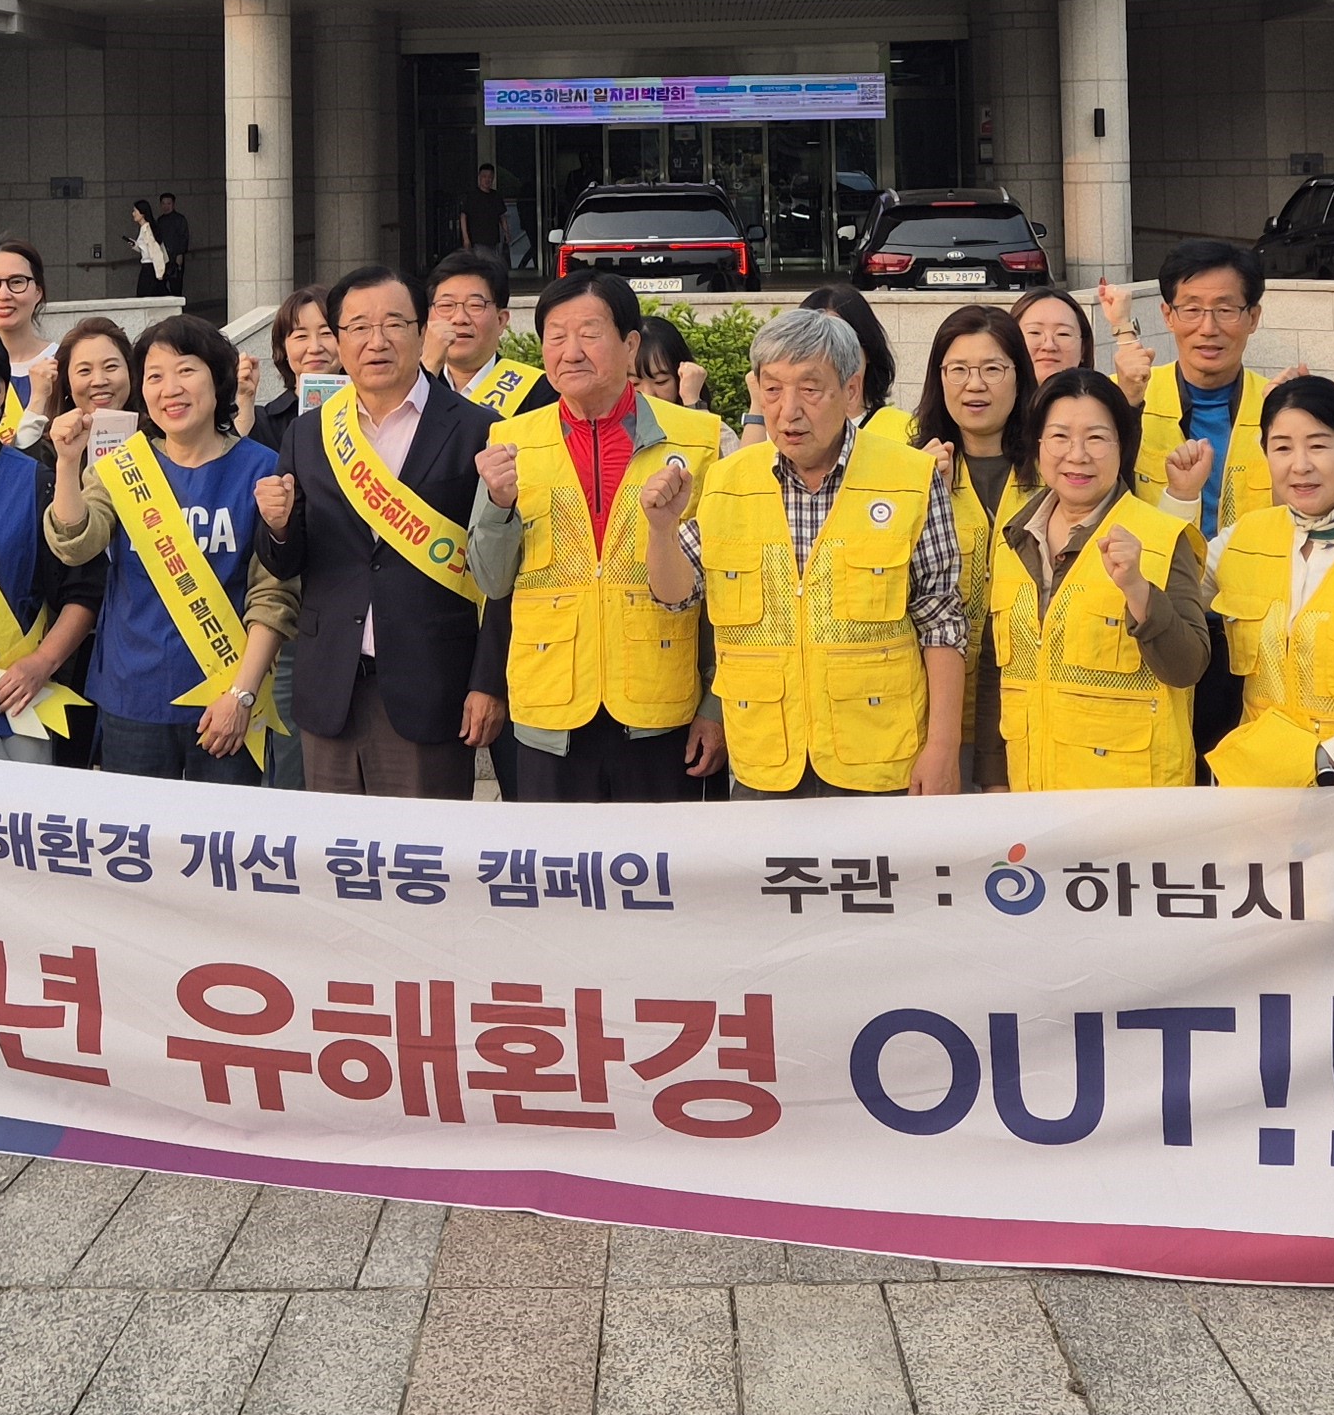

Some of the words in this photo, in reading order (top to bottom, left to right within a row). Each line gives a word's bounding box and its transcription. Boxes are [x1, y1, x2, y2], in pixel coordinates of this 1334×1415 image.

[657, 280, 680, 290] 2697
[956, 272, 981, 282] 2879
[350, 460, 432, 546] 유해환경
[428, 537, 469, 577] OU
[179, 832, 303, 896] 개선
[324, 838, 450, 904] 합동
[475, 848, 675, 912] 캠페인
[760, 856, 899, 915] 주관
[1062, 860, 1306, 921] 하남시
[166, 961, 782, 1140] 유해환경
